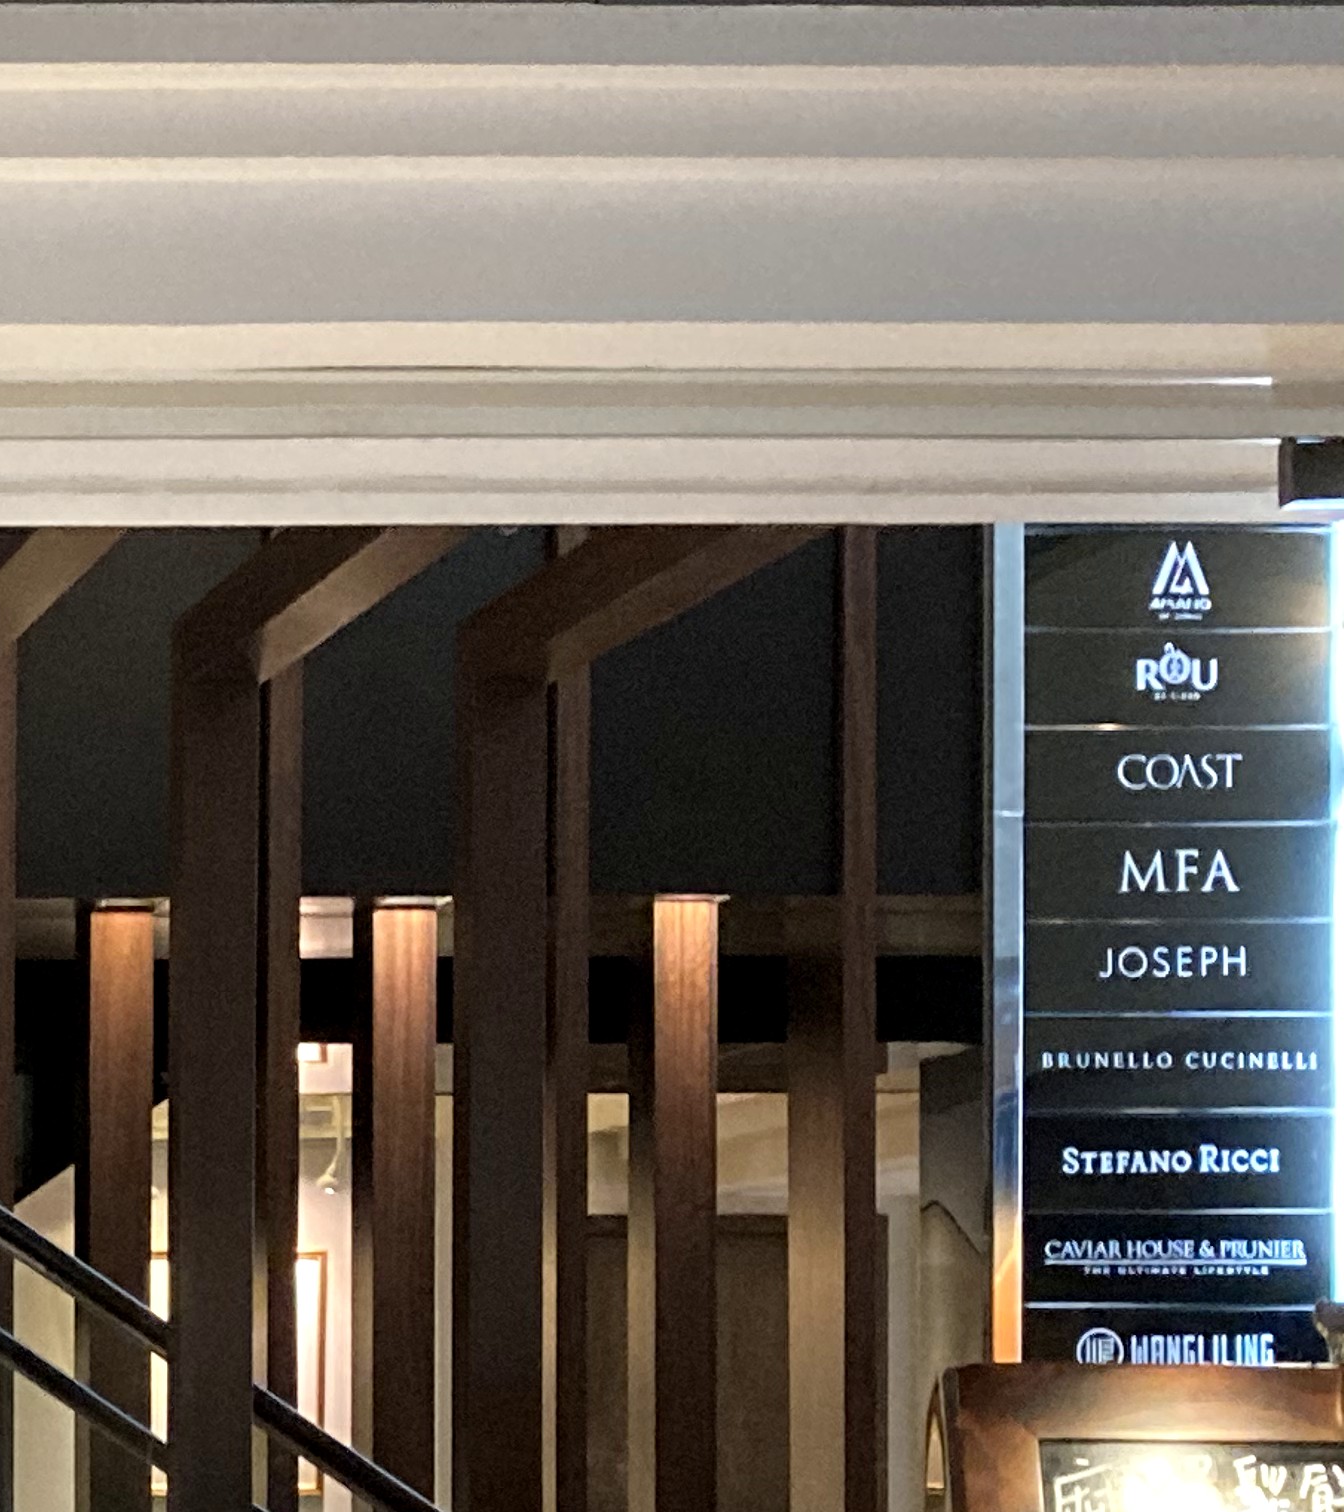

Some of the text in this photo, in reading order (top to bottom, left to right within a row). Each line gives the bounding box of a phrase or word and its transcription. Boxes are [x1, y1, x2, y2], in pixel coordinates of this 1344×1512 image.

[1136, 642, 1218, 691] ROU
[1117, 753, 1243, 790] COAST
[1118, 849, 1240, 893] MFA
[1099, 945, 1247, 979] JOSEPH
[1041, 1051, 1318, 1071] BRUNELLO CUCINELLI
[1044, 1239, 1306, 1260] CAVIAR HOUSE & PRUNIER
